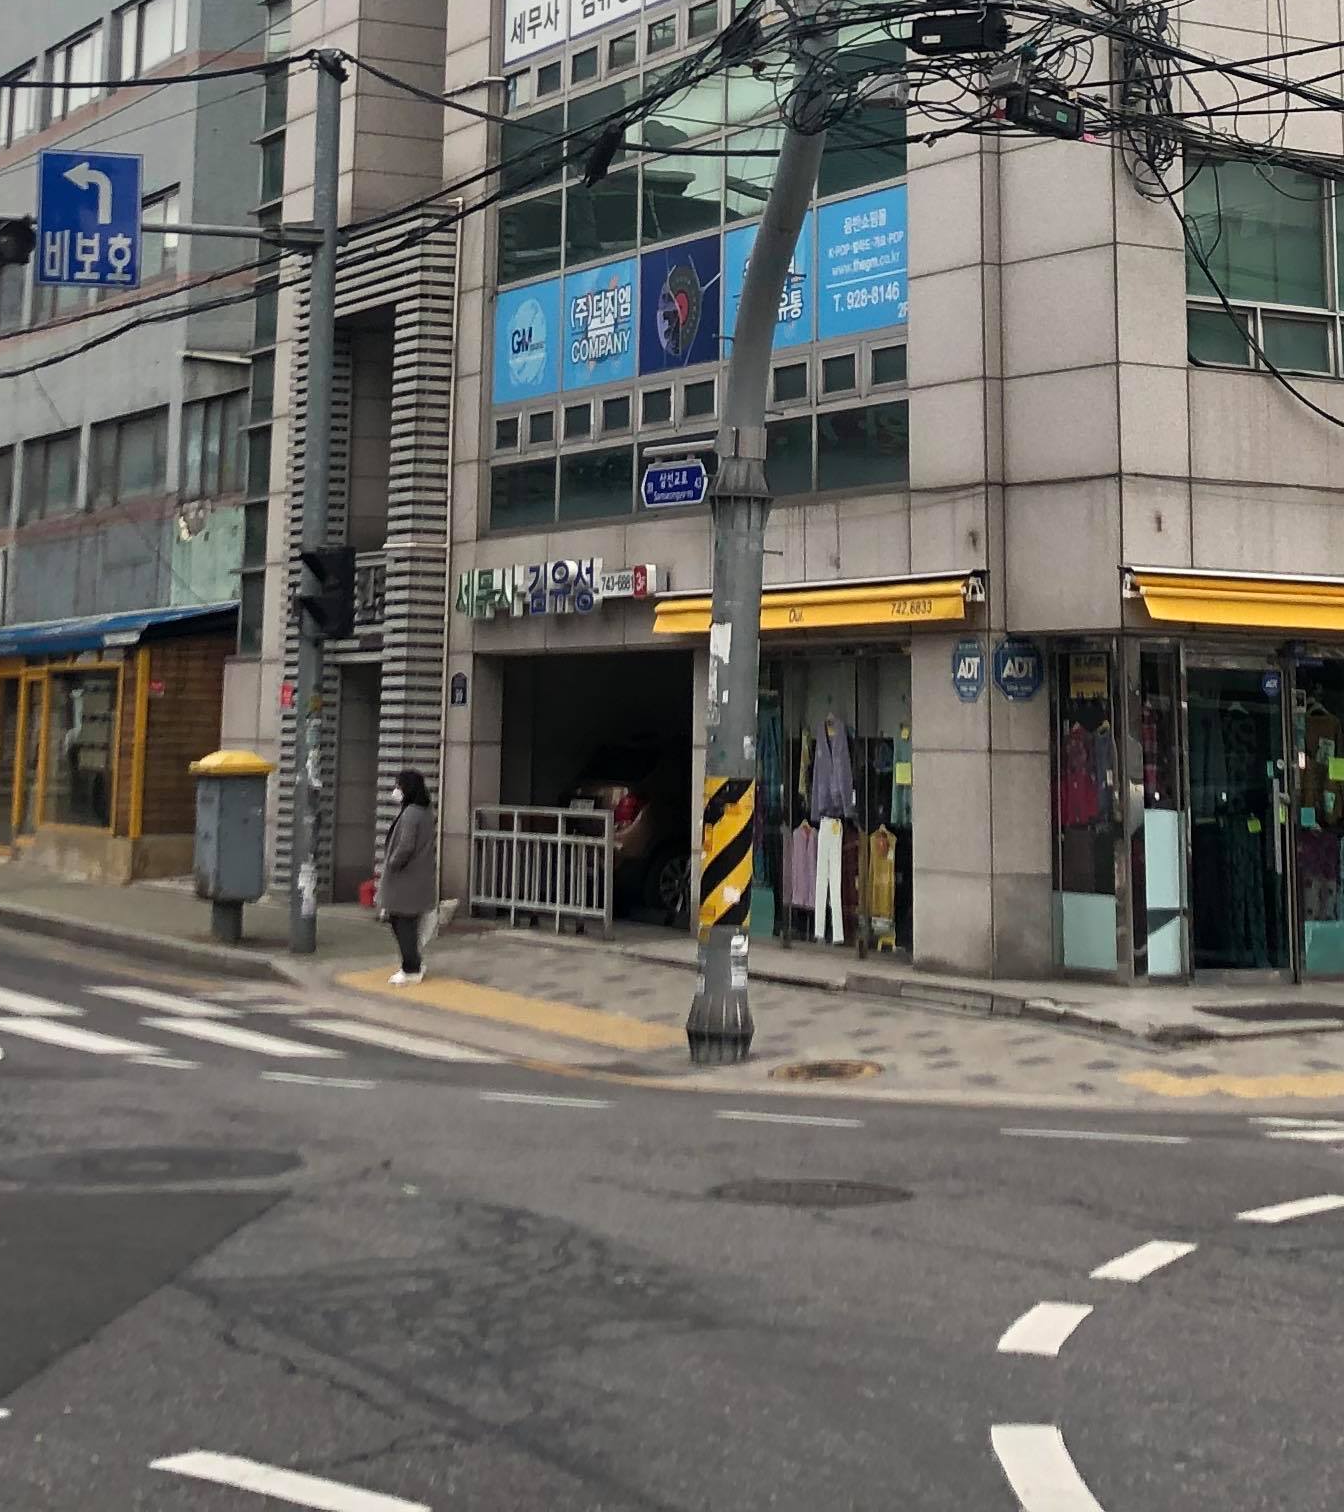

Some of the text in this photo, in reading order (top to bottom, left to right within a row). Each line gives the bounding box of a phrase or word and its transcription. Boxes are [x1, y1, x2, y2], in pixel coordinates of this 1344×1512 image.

[44, 229, 131, 281] 비보호
[846, 281, 900, 311] 928-8146
[571, 330, 632, 364] COMPANY
[528, 557, 599, 614] 김유성
[957, 656, 981, 679] ADT
[1002, 656, 1038, 679] ADT
